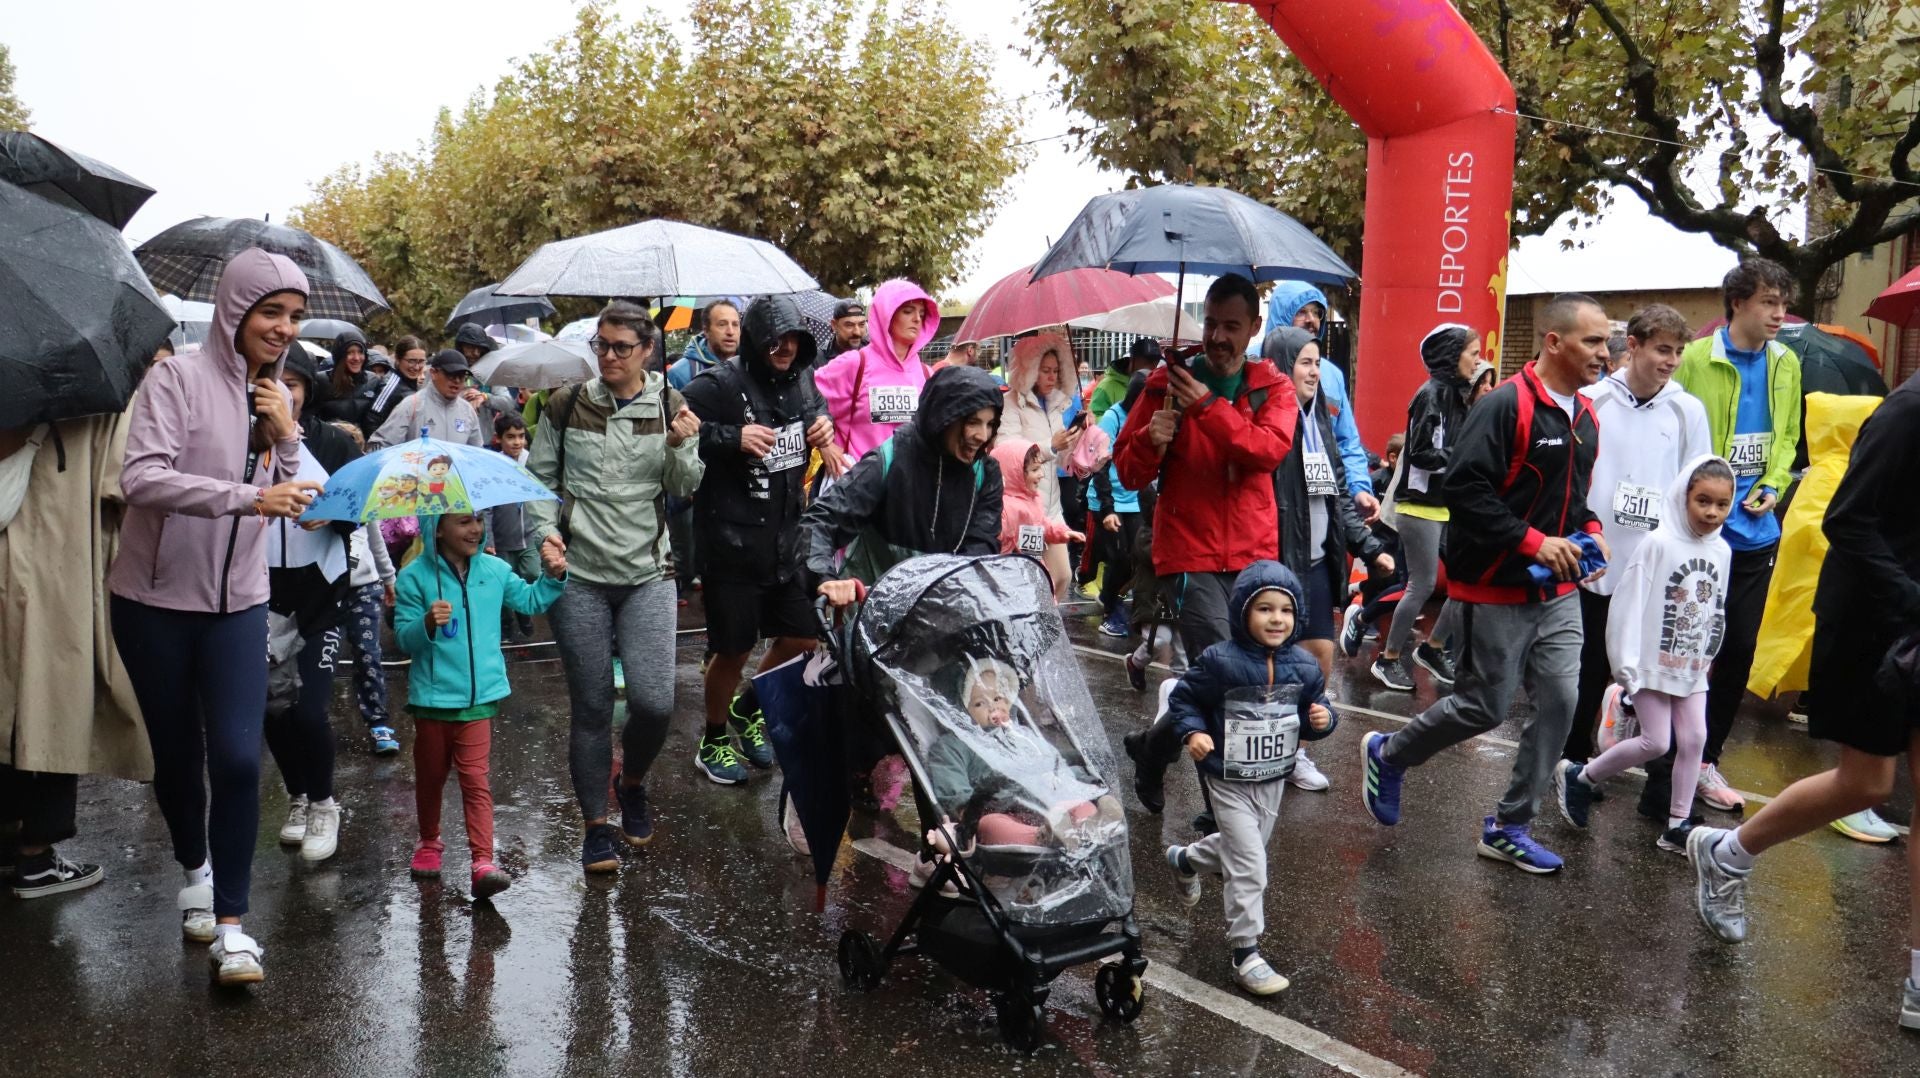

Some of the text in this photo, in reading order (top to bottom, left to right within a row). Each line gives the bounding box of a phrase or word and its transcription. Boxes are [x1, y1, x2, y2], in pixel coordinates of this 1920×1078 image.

[1437, 152, 1473, 313] DEPORTES
[878, 395, 911, 410] 3939
[1729, 444, 1762, 463] 2499
[1622, 494, 1649, 516] 2511
[1660, 604, 1677, 653] ALWAYS
[318, 626, 342, 673] istas
[1246, 734, 1284, 761] 1166
